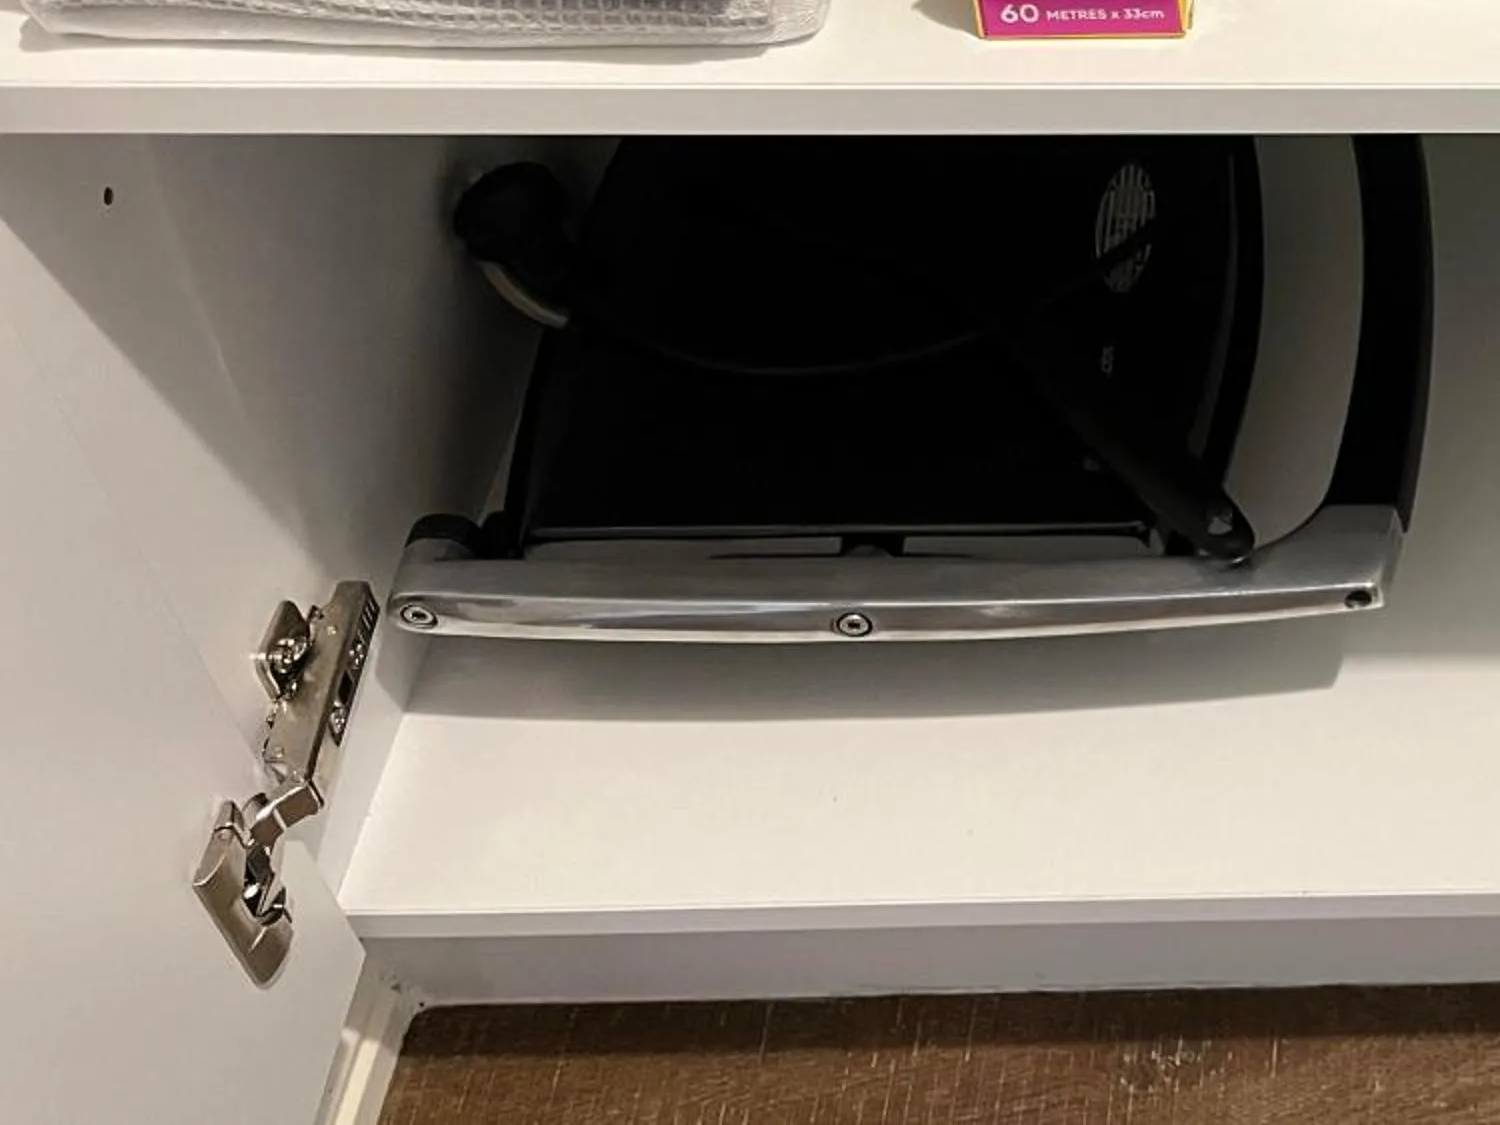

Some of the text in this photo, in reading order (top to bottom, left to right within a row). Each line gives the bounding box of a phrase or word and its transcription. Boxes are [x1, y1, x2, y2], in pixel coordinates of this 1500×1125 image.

[1000, 4, 1165, 23] 60 METRES x 33cm
